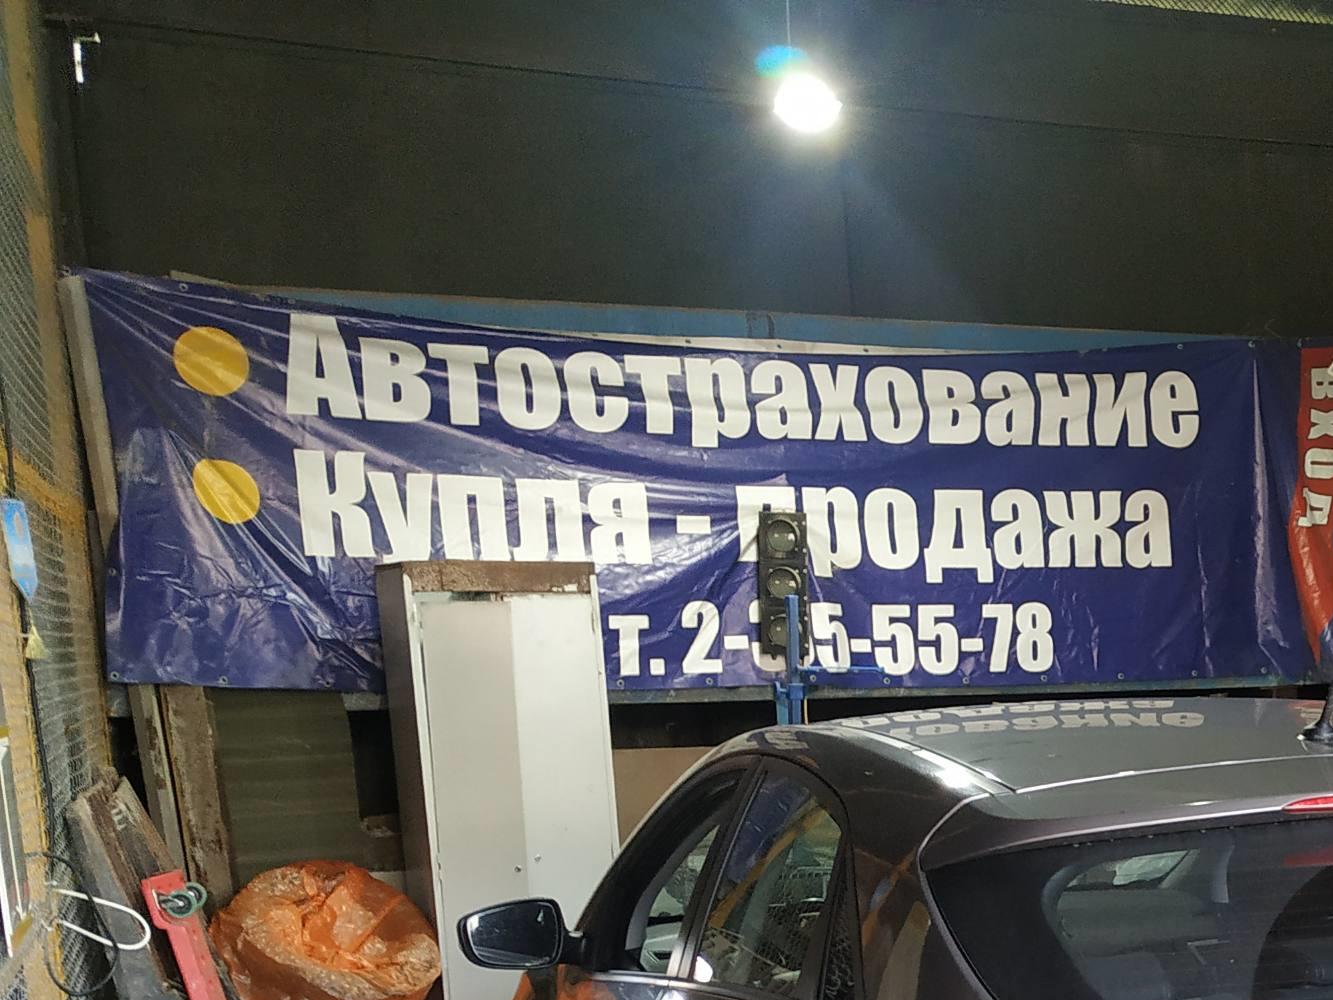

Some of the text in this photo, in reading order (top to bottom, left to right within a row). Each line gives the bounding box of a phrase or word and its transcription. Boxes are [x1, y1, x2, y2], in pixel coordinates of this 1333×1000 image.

[287, 312, 1199, 448] Автострахование
[293, 449, 653, 565] Купля
[735, 485, 1172, 583] продажа
